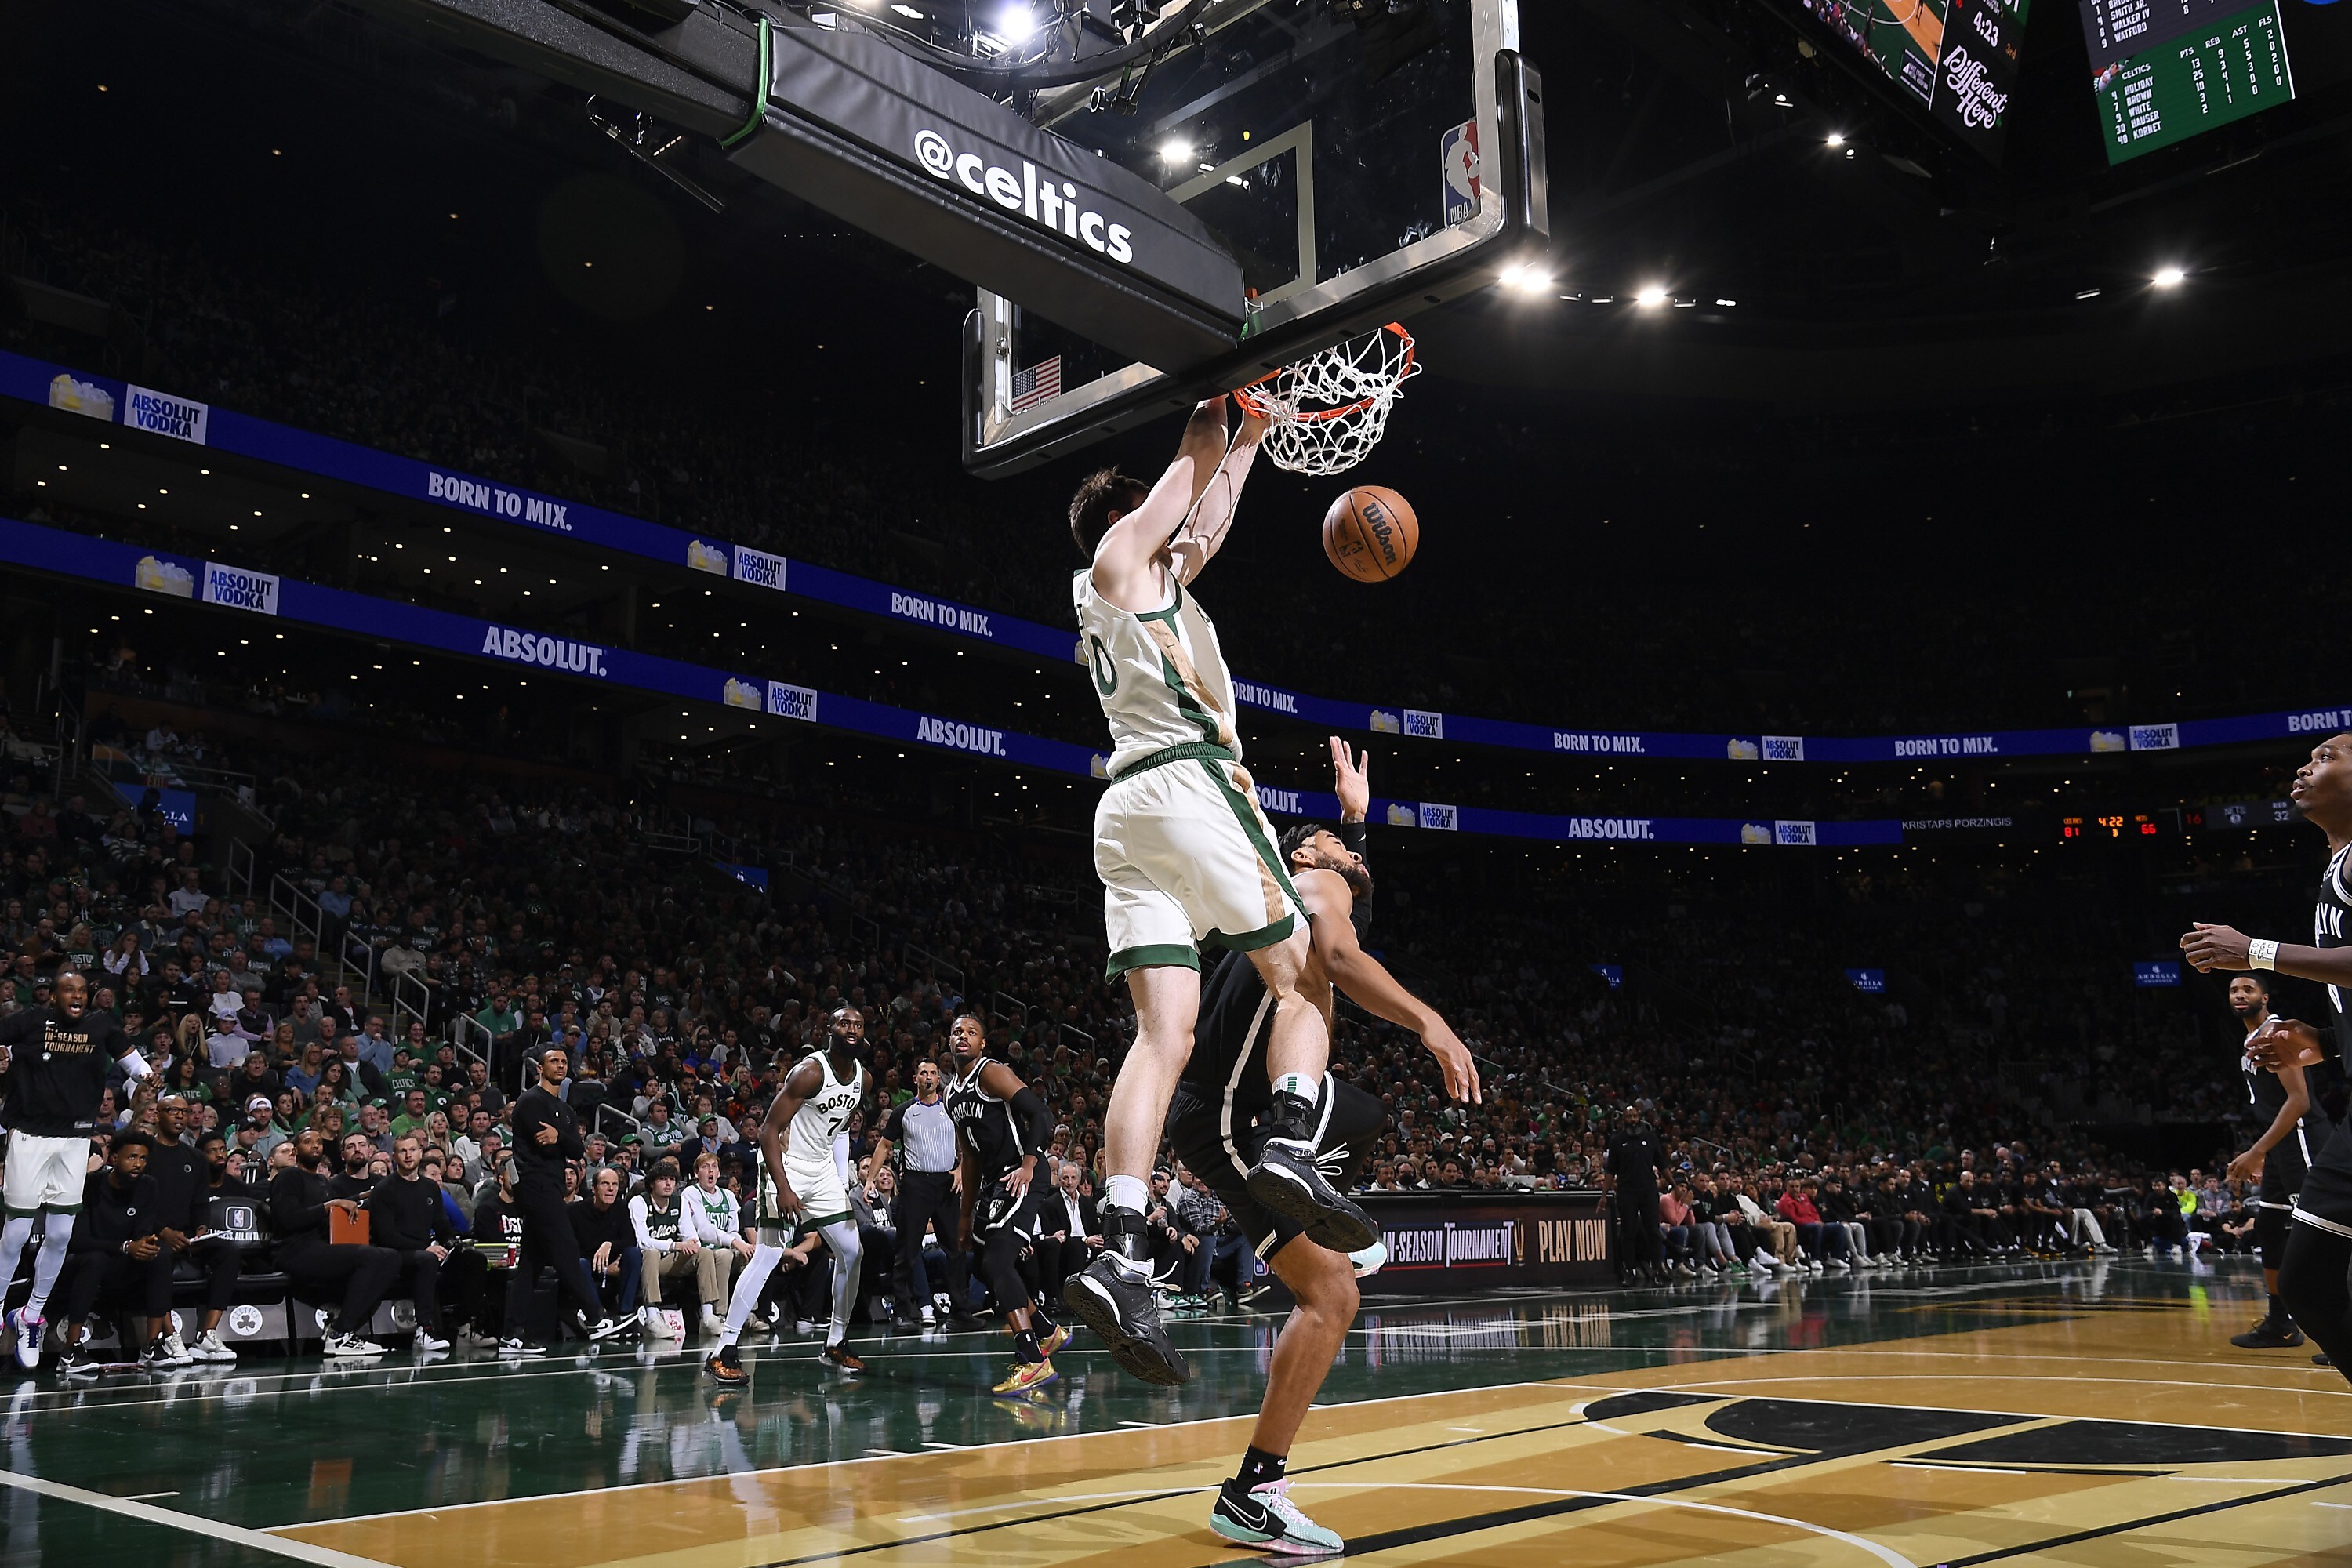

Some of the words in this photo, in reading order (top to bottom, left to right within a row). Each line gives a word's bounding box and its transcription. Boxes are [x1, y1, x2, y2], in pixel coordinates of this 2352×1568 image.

[2110, 3, 2133, 20] SMITH
[2112, 13, 2141, 31] WALKER
[2142, 8, 2151, 20] IV
[1973, 11, 1999, 47] 4:23
[2114, 21, 2147, 43] WATFORD
[2122, 63, 2151, 80] CELTICS
[2180, 46, 2194, 59] PTS
[2205, 36, 2221, 49] REB
[2231, 24, 2248, 38] AST
[2258, 15, 2273, 27] FLS
[2124, 76, 2154, 96] HOLIDAY
[2191, 57, 2201, 69] 13
[2218, 48, 2224, 59] 9
[2243, 38, 2249, 49] 5
[2267, 29, 2274, 39] 2
[1943, 45, 2008, 114] Different
[2114, 101, 2119, 112] 7
[2126, 89, 2152, 107] BROWN
[2192, 70, 2204, 81] 25
[2220, 60, 2227, 71] 3
[2245, 50, 2252, 60] 5
[2269, 41, 2275, 51] 0
[2128, 102, 2151, 118] WHITE
[2195, 81, 2205, 92] 10
[2222, 71, 2228, 82] 4
[2248, 61, 2254, 72] 3
[2271, 53, 2278, 63] 2
[1952, 81, 1997, 129] Here
[2115, 123, 2126, 135] 30
[2130, 110, 2160, 129] HAUSER
[2199, 93, 2206, 103] 3
[2225, 82, 2230, 93] 1
[2249, 73, 2256, 83] 0
[2274, 64, 2280, 74] 0
[2118, 133, 2129, 145] 40
[2132, 121, 2161, 140] KORNET
[2201, 103, 2209, 114] 2
[2227, 94, 2233, 104] 1
[2252, 85, 2259, 95] 0
[2276, 75, 2282, 86] 0
[913, 129, 1134, 264] @celtics
[1450, 201, 1470, 223] NBA
[132, 394, 201, 425] ABSOLUT
[136, 410, 193, 439] VODKA
[429, 471, 490, 510] BORN
[494, 489, 521, 517] TO
[526, 497, 572, 532] MIX.
[1362, 502, 1397, 566] Wilson
[739, 552, 782, 575] ABSOLUT
[210, 570, 272, 596] ABSOLUT
[742, 565, 777, 587] VODKA
[214, 585, 265, 610] VODKA
[891, 592, 935, 622] BORN
[937, 604, 956, 627] TO
[959, 609, 993, 637] MIX.
[482, 626, 607, 677] ABSOLUT.
[772, 687, 814, 707] ABSOLUT
[1232, 681, 1254, 703] ORN
[1256, 687, 1271, 707] TO
[1272, 691, 1298, 714] MIX.
[775, 700, 809, 719] VODKA
[1407, 714, 1439, 728] ABSOLUT
[1410, 724, 1436, 736] VODKA
[2288, 711, 2339, 732] BORN
[2340, 710, 2352, 726] T
[916, 716, 1007, 757] ABSOLUT.
[1553, 732, 1589, 751] BORN
[1591, 735, 1610, 752] TO
[1613, 735, 1646, 753] MIX.
[1766, 740, 1799, 750] ABSOLUT
[1894, 739, 1937, 757] BORN
[1939, 739, 1960, 754] TO
[1962, 737, 1998, 753] MIX.
[1768, 750, 1797, 759] VODKA
[1255, 785, 1303, 814] SOLUT.
[1423, 807, 1454, 819] ABSOLUT
[1425, 817, 1451, 829] VODKA
[1902, 819, 1952, 830] KRISTAPS
[1955, 818, 2012, 828] PORZINGIS
[2274, 811, 2290, 822] 32
[1568, 818, 1655, 840] ABSOLUT.
[1779, 825, 1812, 835] ABSOLUT
[1781, 834, 1809, 844] VODKA
[2064, 826, 2079, 837] 81
[2141, 823, 2156, 834] 66
[44, 1041, 96, 1054] TOURNAMENT
[45, 1032, 89, 1044] IN-SEASON
[392, 1078, 415, 1090] CELTICS
[816, 1094, 858, 1114] BOSTO
[951, 1101, 984, 1127] ROOKLYN
[827, 1116, 844, 1137] 7
[967, 1126, 981, 1152] 4
[1443, 1220, 1515, 1268] TOURNAMENT
[1537, 1219, 1573, 1264] PLAY
[1574, 1218, 1607, 1262] NOW
